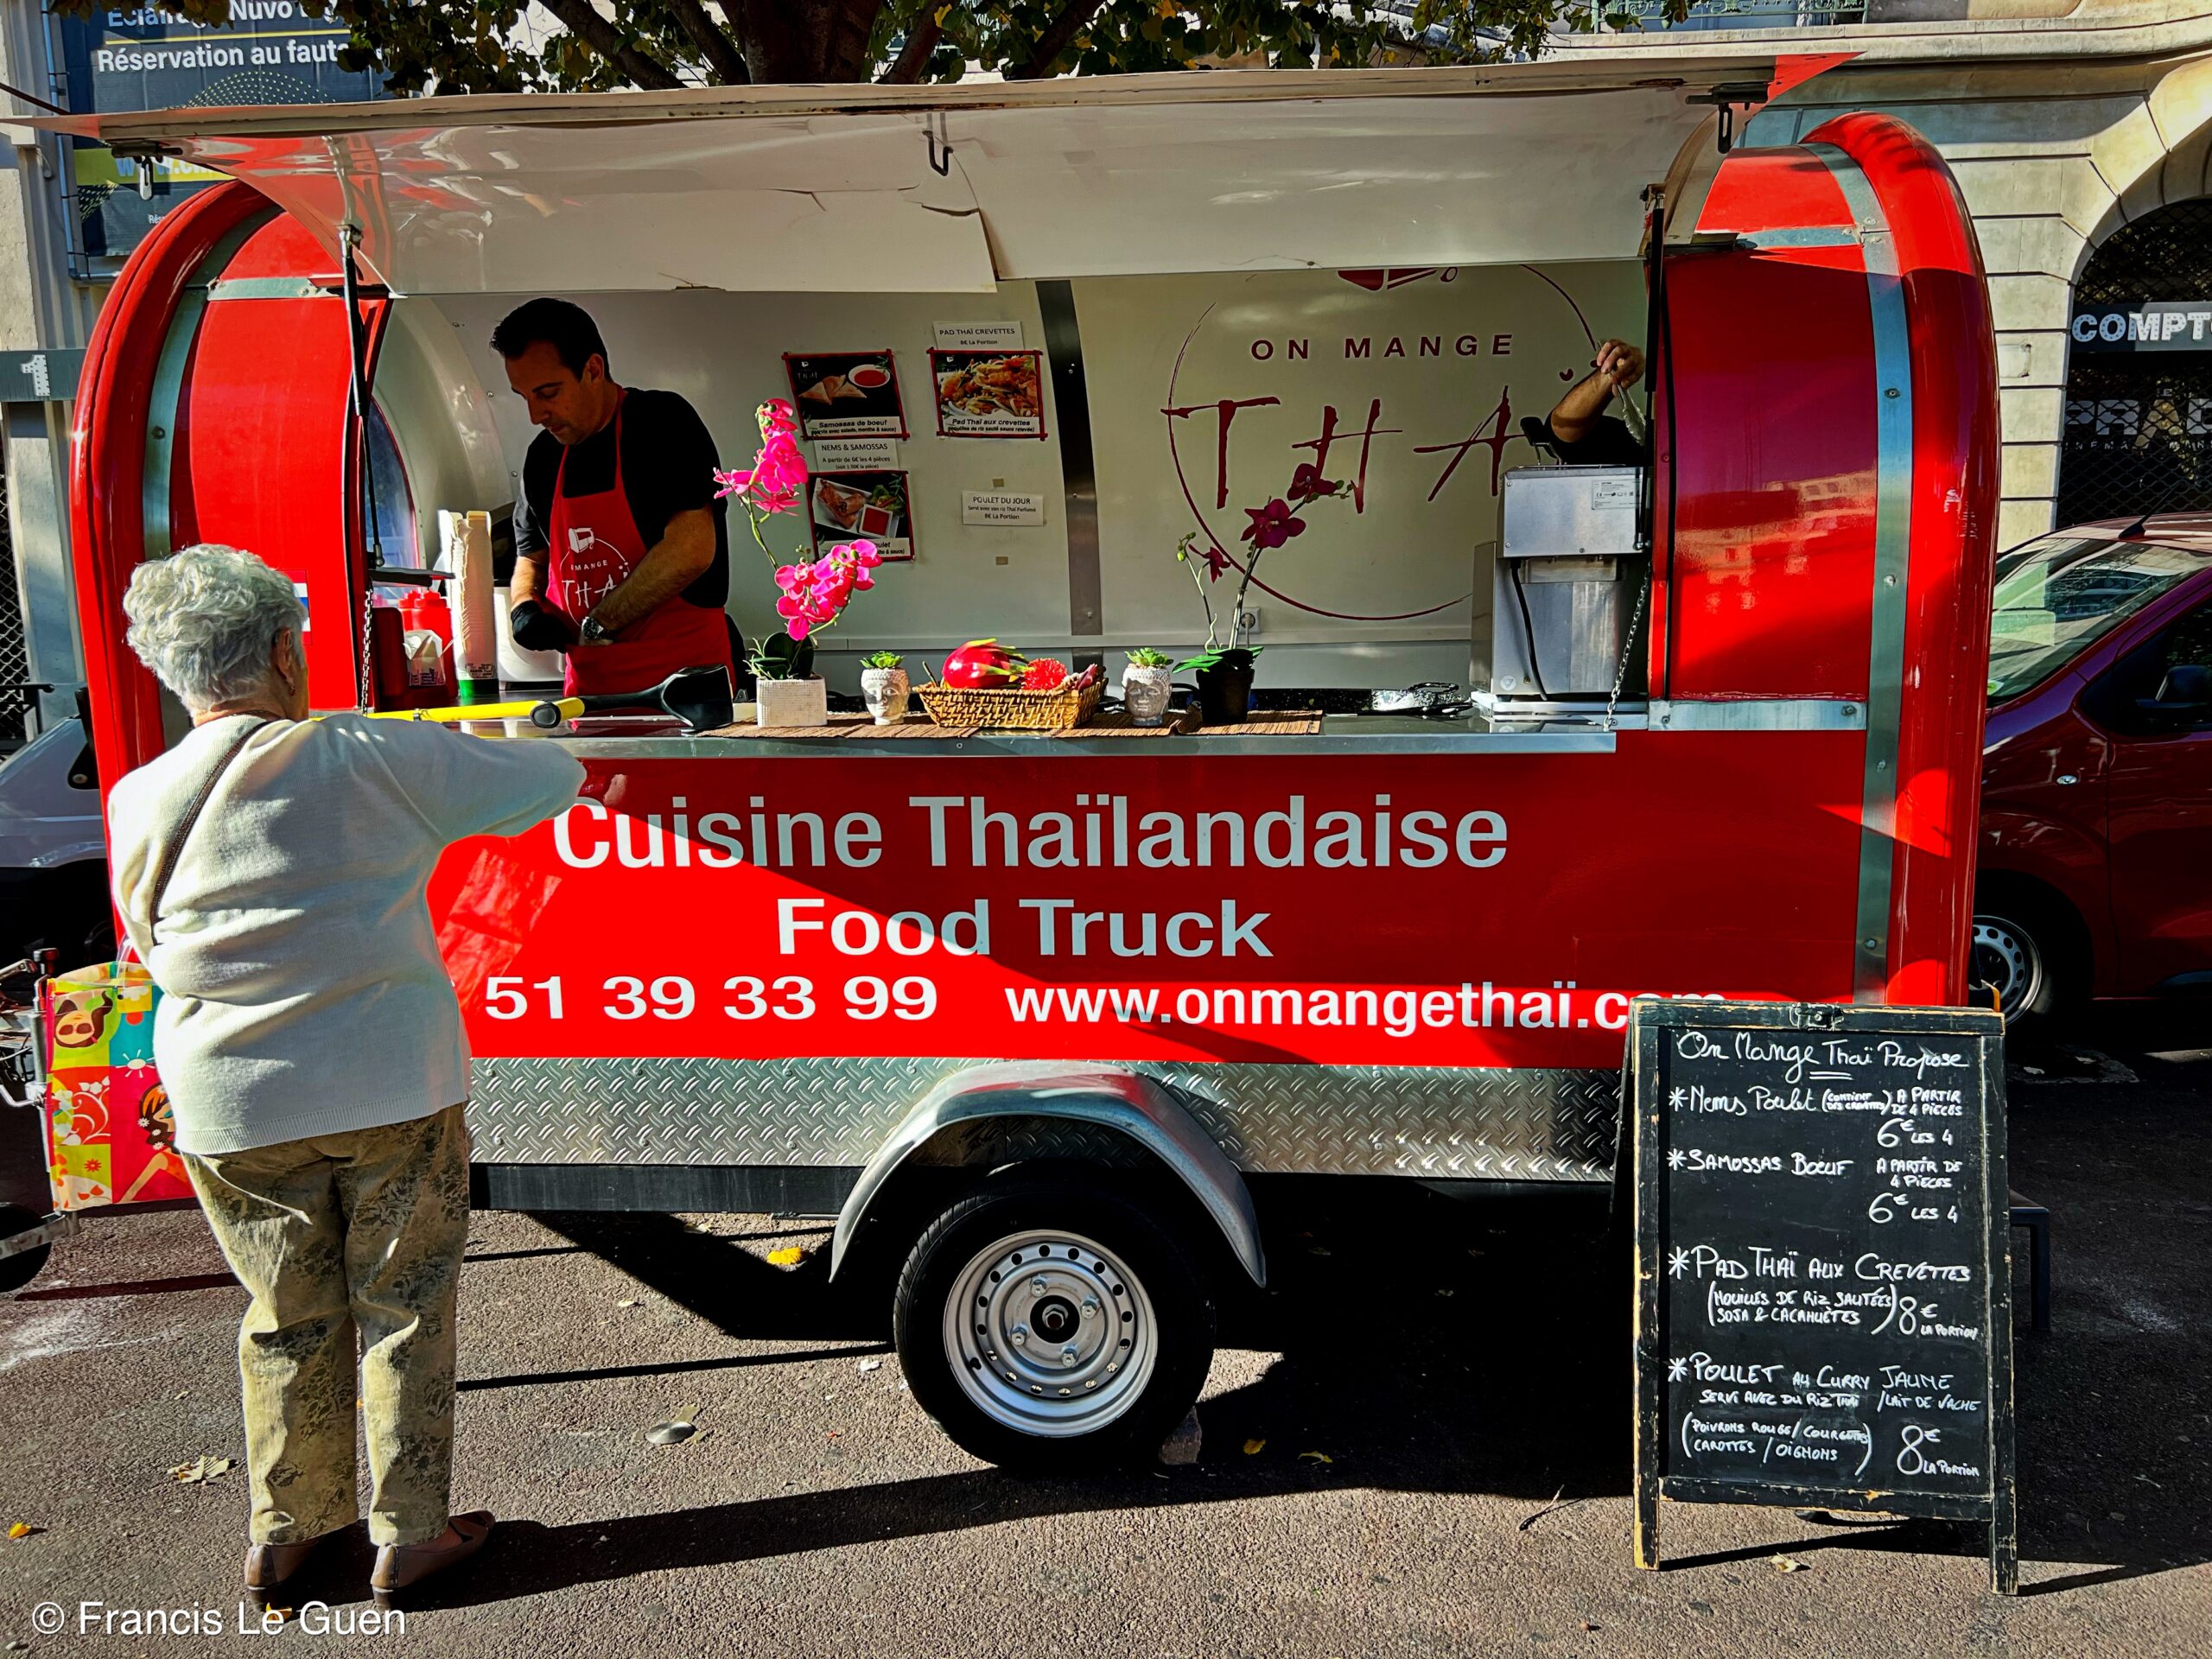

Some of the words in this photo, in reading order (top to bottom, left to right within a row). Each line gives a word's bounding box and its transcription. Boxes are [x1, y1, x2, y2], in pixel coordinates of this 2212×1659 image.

[229, 0, 294, 21] Nuvo
[98, 44, 245, 73] Réservation
[250, 46, 281, 65] au
[2071, 313, 2212, 342] COMPT
[1250, 338, 1310, 360] ON
[1344, 333, 1514, 359] MANGE
[21, 354, 51, 397] 1
[1160, 385, 1528, 514] THA
[553, 795, 883, 868] Cuisine
[908, 793, 1508, 868] Thaïlandaise
[777, 899, 990, 955] Food
[1019, 899, 1274, 957] Truck
[485, 976, 564, 1020] 51
[602, 976, 696, 1020] 39
[723, 976, 817, 1020] 33
[842, 976, 938, 1020] 99
[1677, 1031, 1729, 1059] On
[1735, 1032, 1821, 1084] Mange
[1821, 1039, 1873, 1065] Thaï
[1877, 1041, 1970, 1080] Propose
[1690, 1084, 1747, 1116] Nems
[1897, 1089, 1907, 1103] A
[1910, 1086, 1961, 1103] PARTIR
[1891, 1103, 1907, 1116] DE
[1909, 1104, 1918, 1116] 4
[1910, 1132, 1936, 1145] LES
[1942, 1129, 1954, 1146] 4
[1876, 1159, 1887, 1174] A
[1943, 1160, 1962, 1173] DE
[1890, 1177, 1901, 1189] 4
[1910, 1208, 1938, 1220] LES
[1947, 1207, 1959, 1224] 4
[1808, 1257, 1843, 1278] AUX
[1776, 1291, 1797, 1305] DE
[1716, 1307, 1749, 1324] SOJA
[1754, 1306, 1769, 1322] &
[1920, 1325, 1933, 1336] LA
[1792, 1371, 1810, 1389] AU
[1744, 1392, 1777, 1405] AVEC
[1782, 1393, 1802, 1406] DU
[1916, 1396, 1933, 1408] DE
[1923, 1463, 1936, 1473] LA
